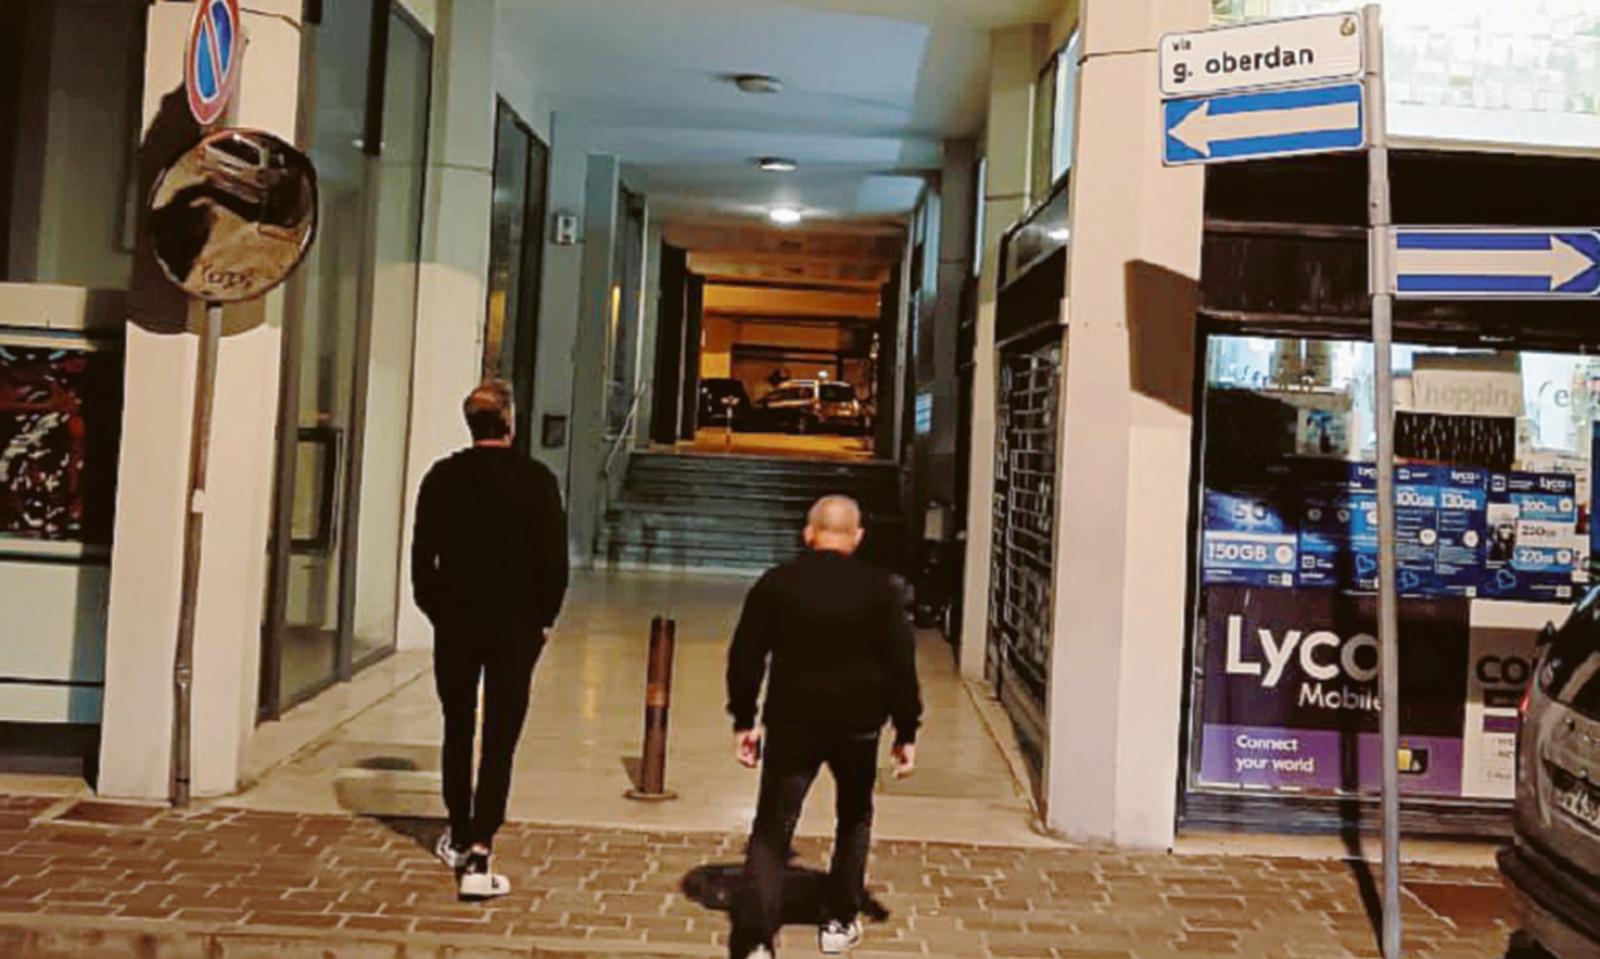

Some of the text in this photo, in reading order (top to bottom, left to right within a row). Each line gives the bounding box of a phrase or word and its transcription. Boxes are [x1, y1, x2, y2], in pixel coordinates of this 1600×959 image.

[1172, 39, 1192, 51] via
[1172, 45, 1314, 84] g. oberdan
[1235, 734, 1298, 752] Connect
[1235, 756, 1316, 774] your world
